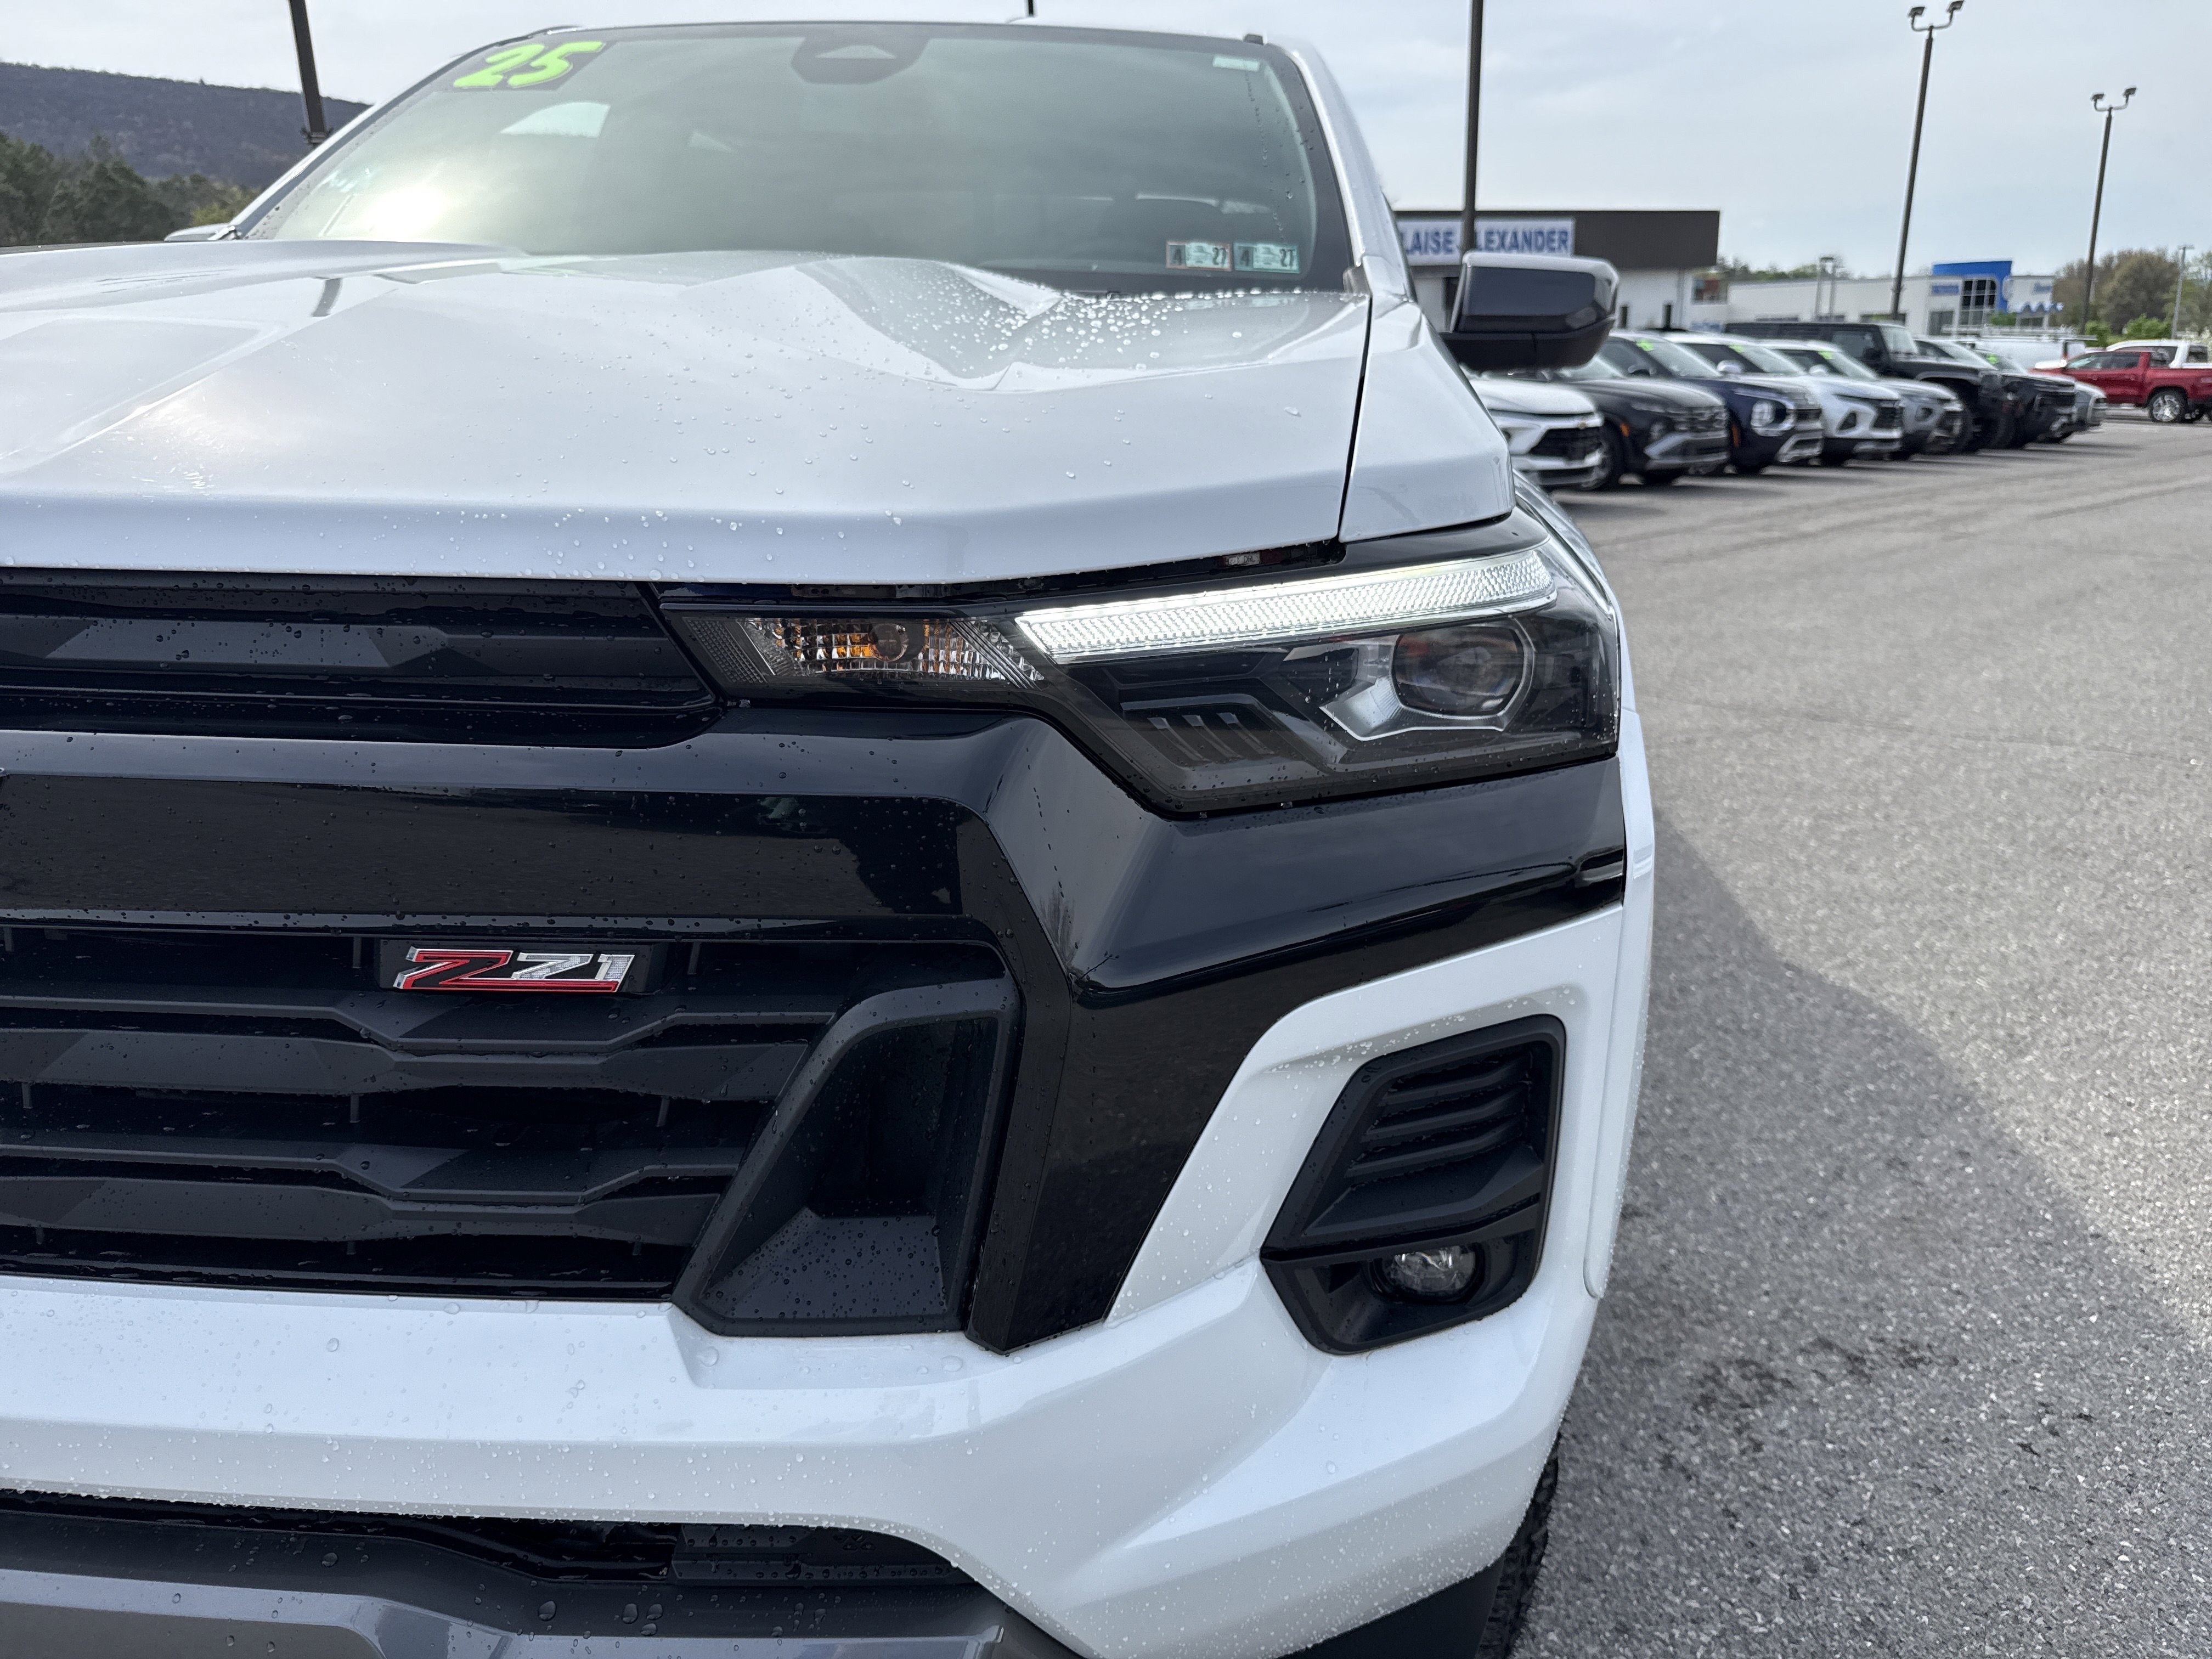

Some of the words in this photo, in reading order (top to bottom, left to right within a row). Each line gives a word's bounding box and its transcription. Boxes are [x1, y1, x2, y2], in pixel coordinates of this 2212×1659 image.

[453, 41, 605, 88] 25
[1400, 230, 1454, 255] LAISE
[1457, 228, 1568, 252] LEXANDER
[393, 946, 635, 993] Z71
